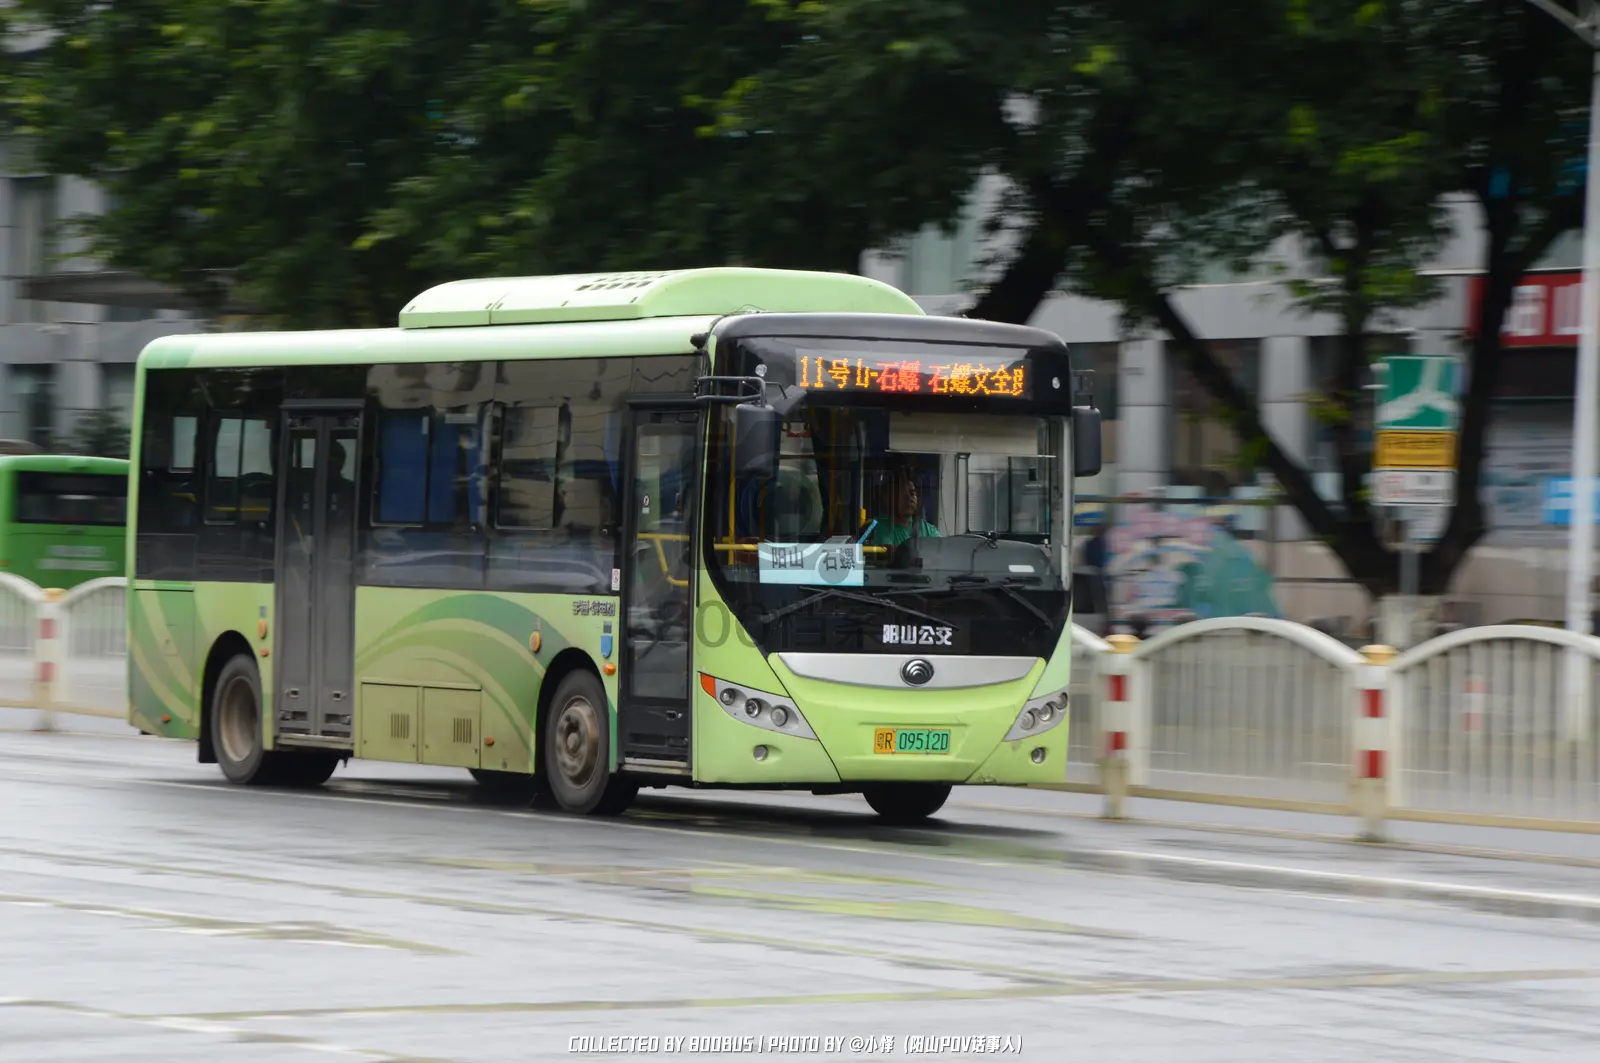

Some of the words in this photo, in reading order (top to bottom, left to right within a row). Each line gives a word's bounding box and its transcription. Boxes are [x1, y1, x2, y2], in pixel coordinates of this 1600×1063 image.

[771, 546, 804, 569] 阳山
[882, 623, 953, 646] 阳山公交
[899, 731, 949, 751] 09512D
